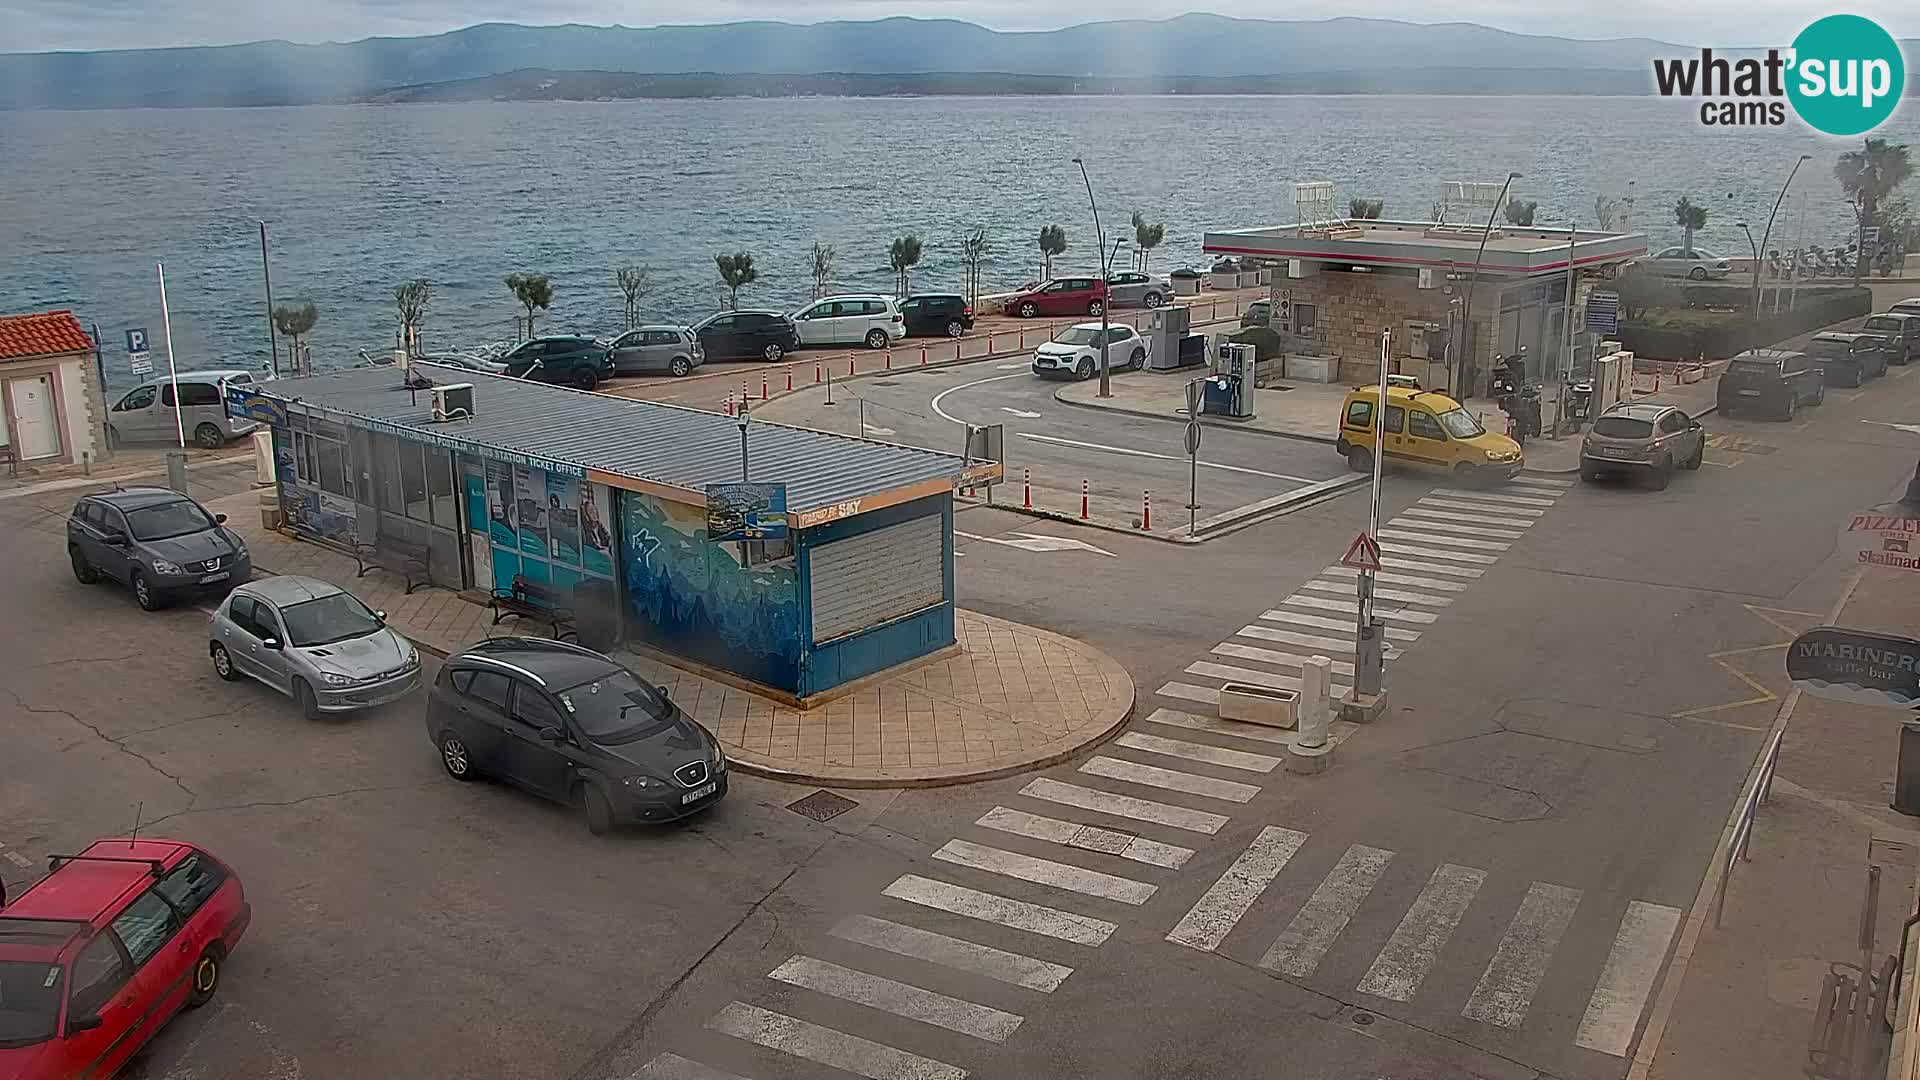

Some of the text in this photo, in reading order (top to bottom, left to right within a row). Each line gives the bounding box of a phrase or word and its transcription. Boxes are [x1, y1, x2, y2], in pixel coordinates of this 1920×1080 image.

[131, 331, 144, 350] P
[437, 435, 468, 451] POSTAJA
[494, 449, 527, 466] STATION
[528, 456, 555, 471] TICKET
[556, 463, 583, 477] OFFICE
[1847, 515, 1920, 534] PIZZE
[1868, 666, 1896, 681] bar
